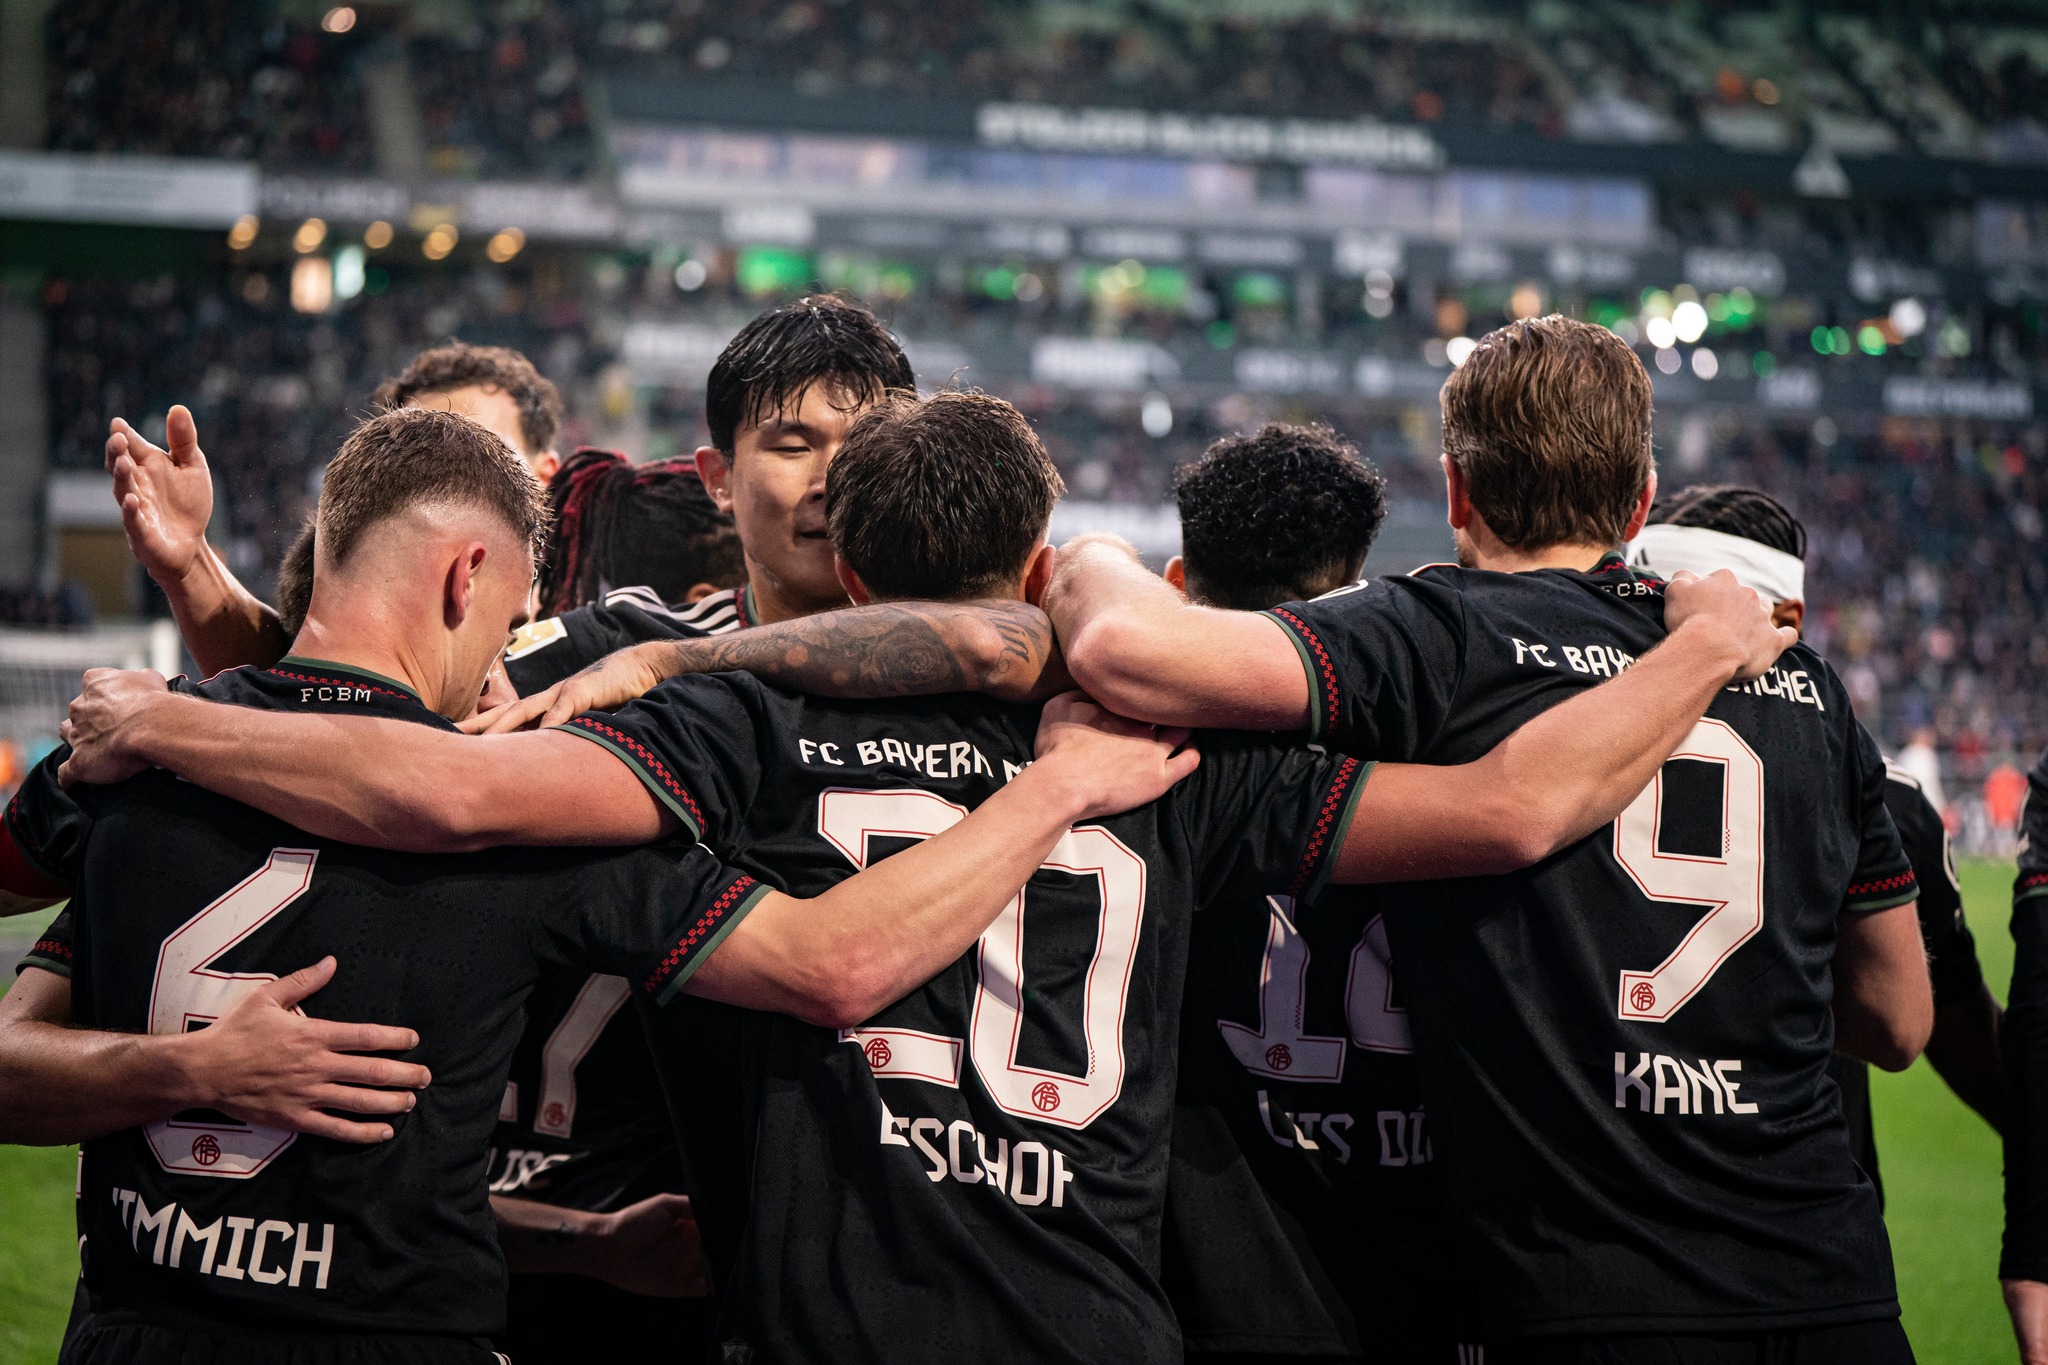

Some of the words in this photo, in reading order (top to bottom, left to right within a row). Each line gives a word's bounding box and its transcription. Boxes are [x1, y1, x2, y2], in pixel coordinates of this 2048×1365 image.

[1601, 582, 1654, 597] FCB
[1512, 638, 1557, 667] FC
[1562, 645, 1640, 677] BAY
[300, 687, 371, 702] FCBM
[799, 738, 845, 766] FC
[1613, 716, 1764, 1023] 9
[498, 972, 632, 1139] 7
[1614, 1052, 1759, 1114] KANE
[112, 1187, 335, 1290] IMMICH
